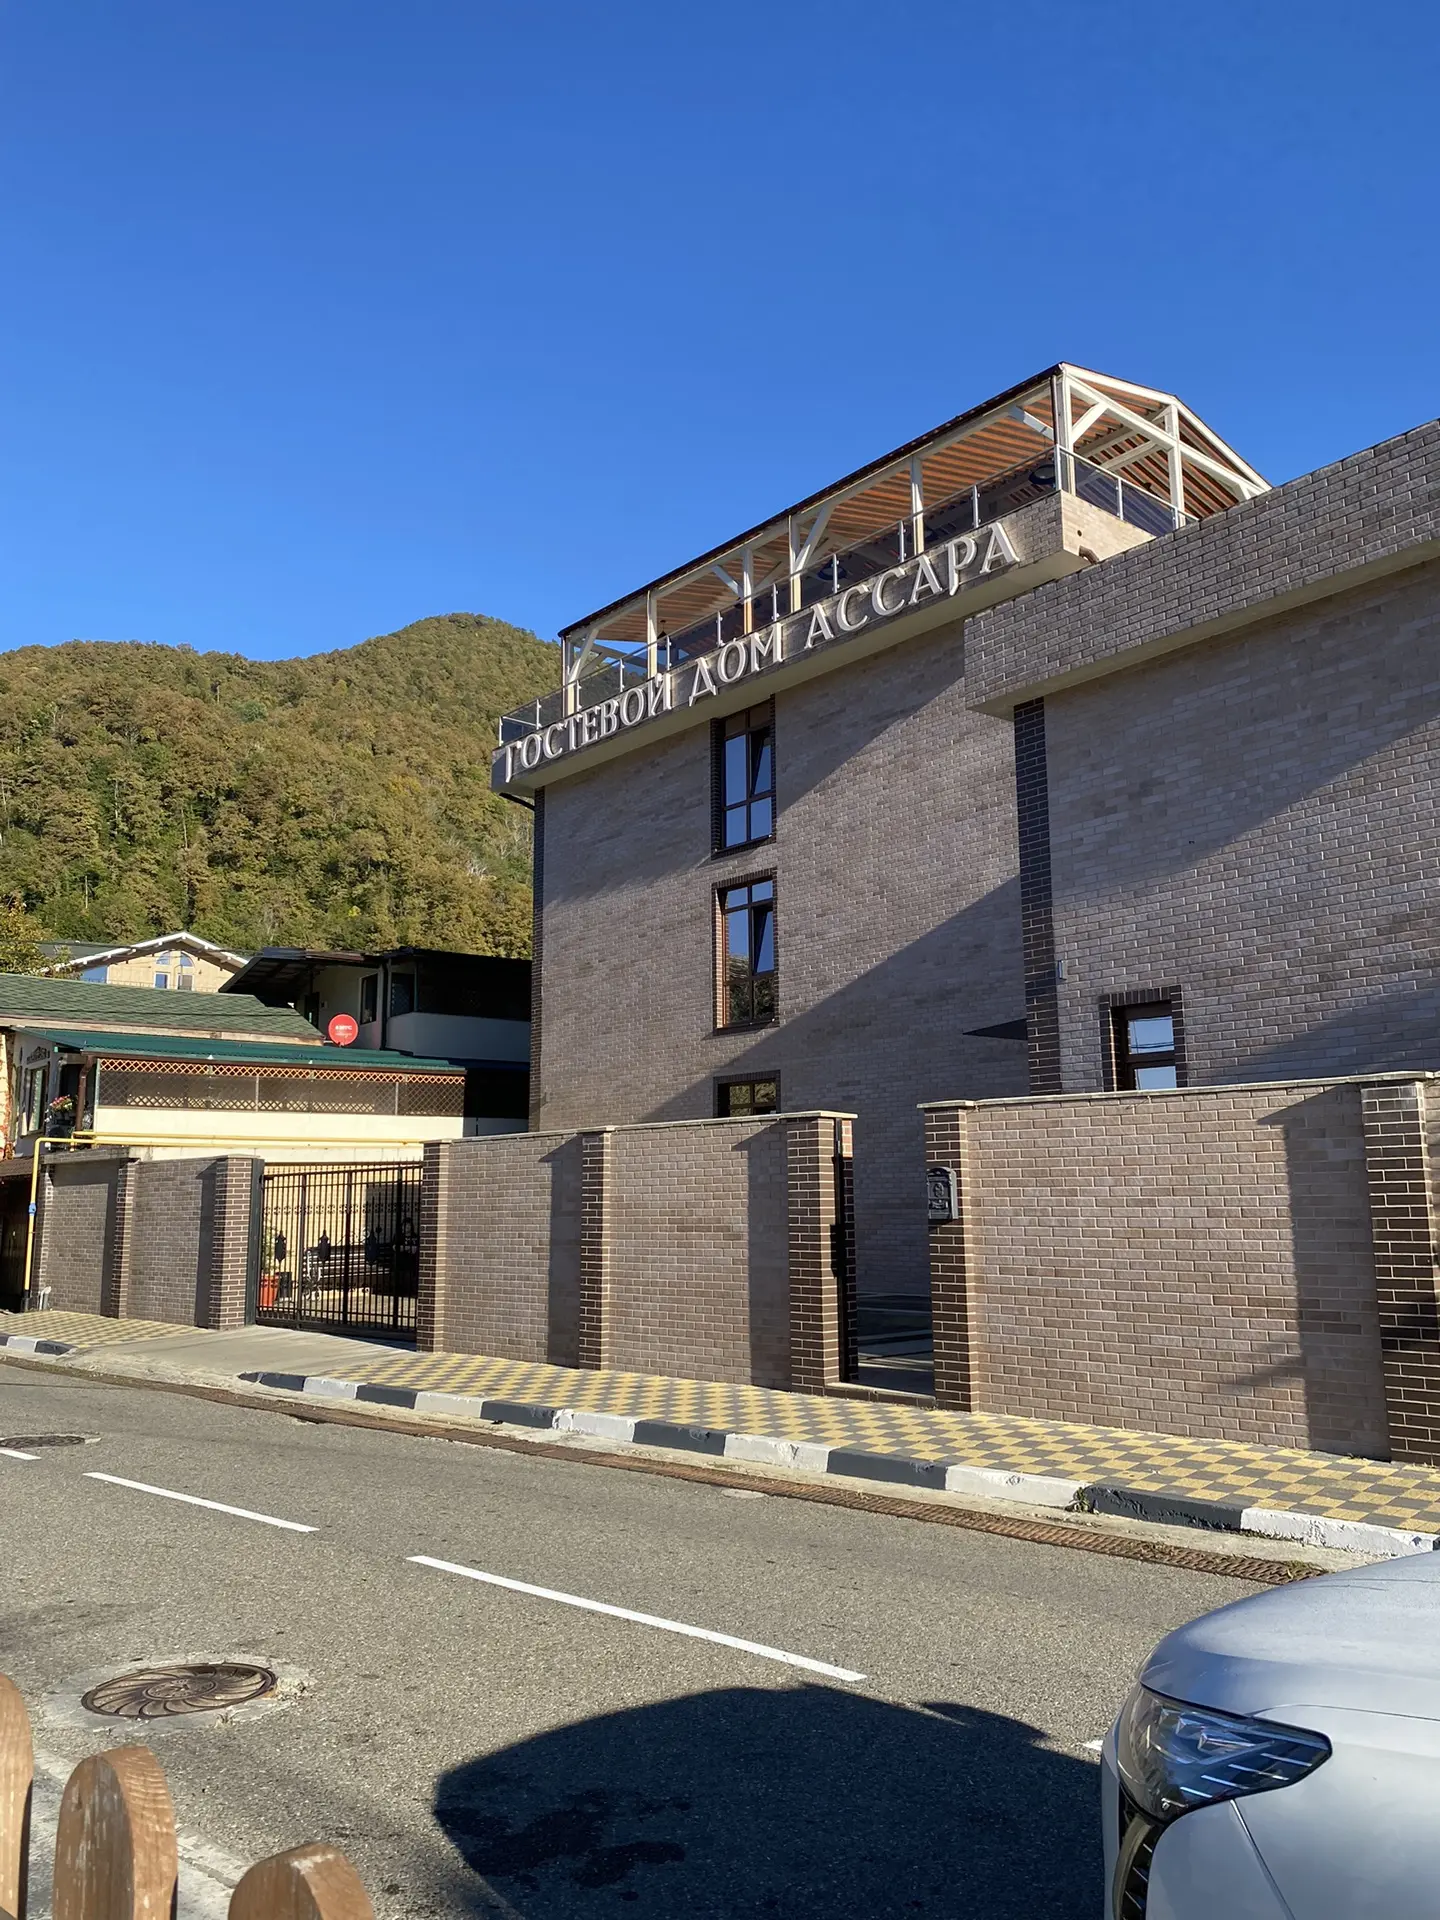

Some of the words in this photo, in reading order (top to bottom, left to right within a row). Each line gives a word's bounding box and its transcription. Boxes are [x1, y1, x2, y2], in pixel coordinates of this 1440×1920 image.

[505, 673, 672, 783] ГОСТЕВОЙ
[688, 622, 783, 707] ДОМ
[804, 521, 1021, 650] АССАРА
